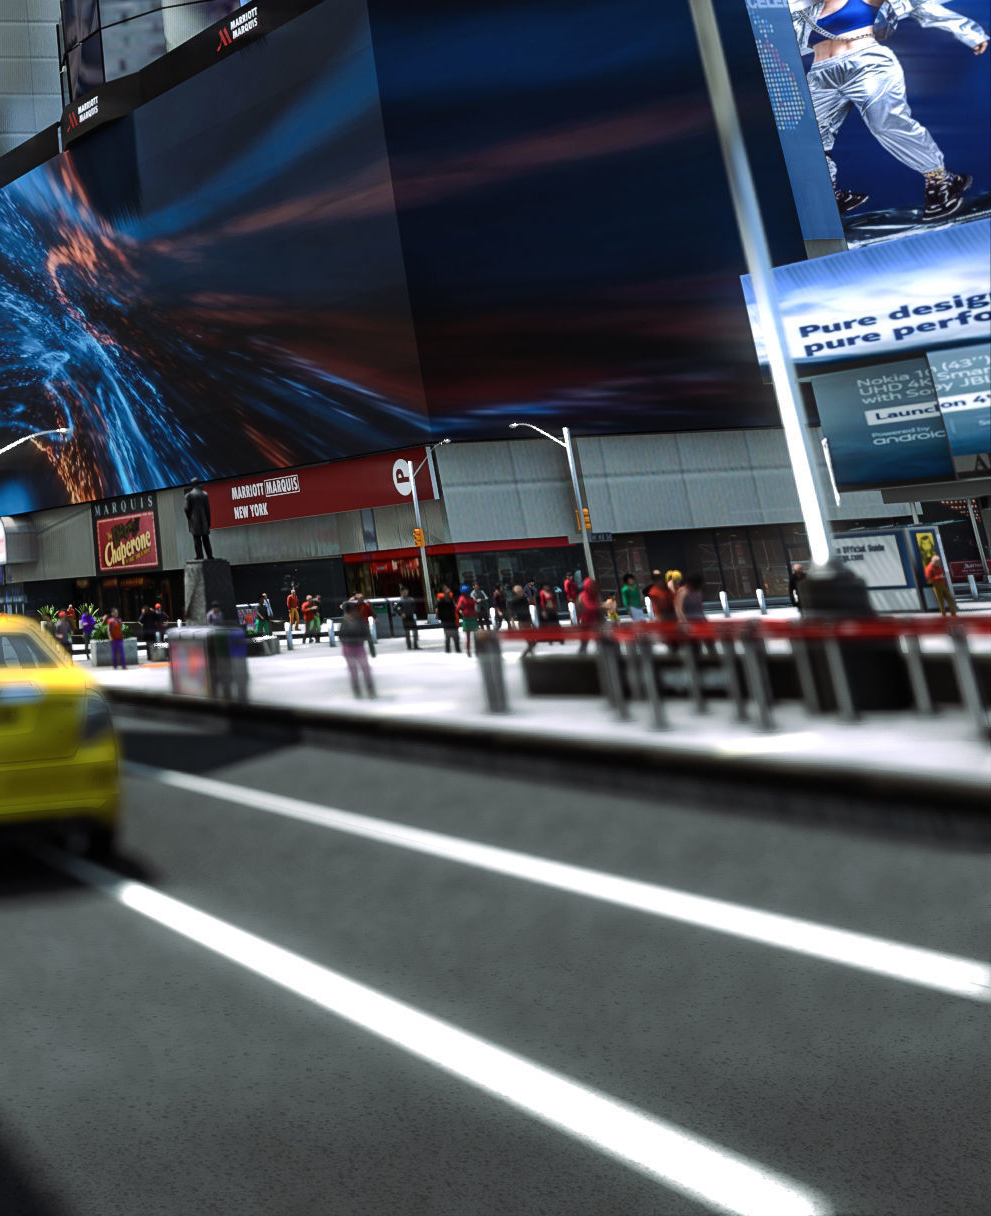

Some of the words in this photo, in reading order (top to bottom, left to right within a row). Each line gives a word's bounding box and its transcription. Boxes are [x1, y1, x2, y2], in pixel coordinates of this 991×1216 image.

[230, 6, 258, 31] MARRIOTT
[232, 17, 258, 40] MARQUIS
[799, 315, 877, 338] Pure
[888, 291, 991, 321] desig
[804, 330, 882, 357] pure
[856, 371, 910, 389] Nokia
[859, 382, 903, 397] UHD
[908, 378, 932, 388] 4K
[861, 392, 902, 405] with
[231, 482, 265, 501] MARRIOTT
[265, 476, 299, 496] MARQUIS
[94, 495, 154, 517] MARQUIS
[233, 505, 249, 520] NEW
[249, 502, 268, 518] YORK
[104, 530, 152, 567] Chaperone
